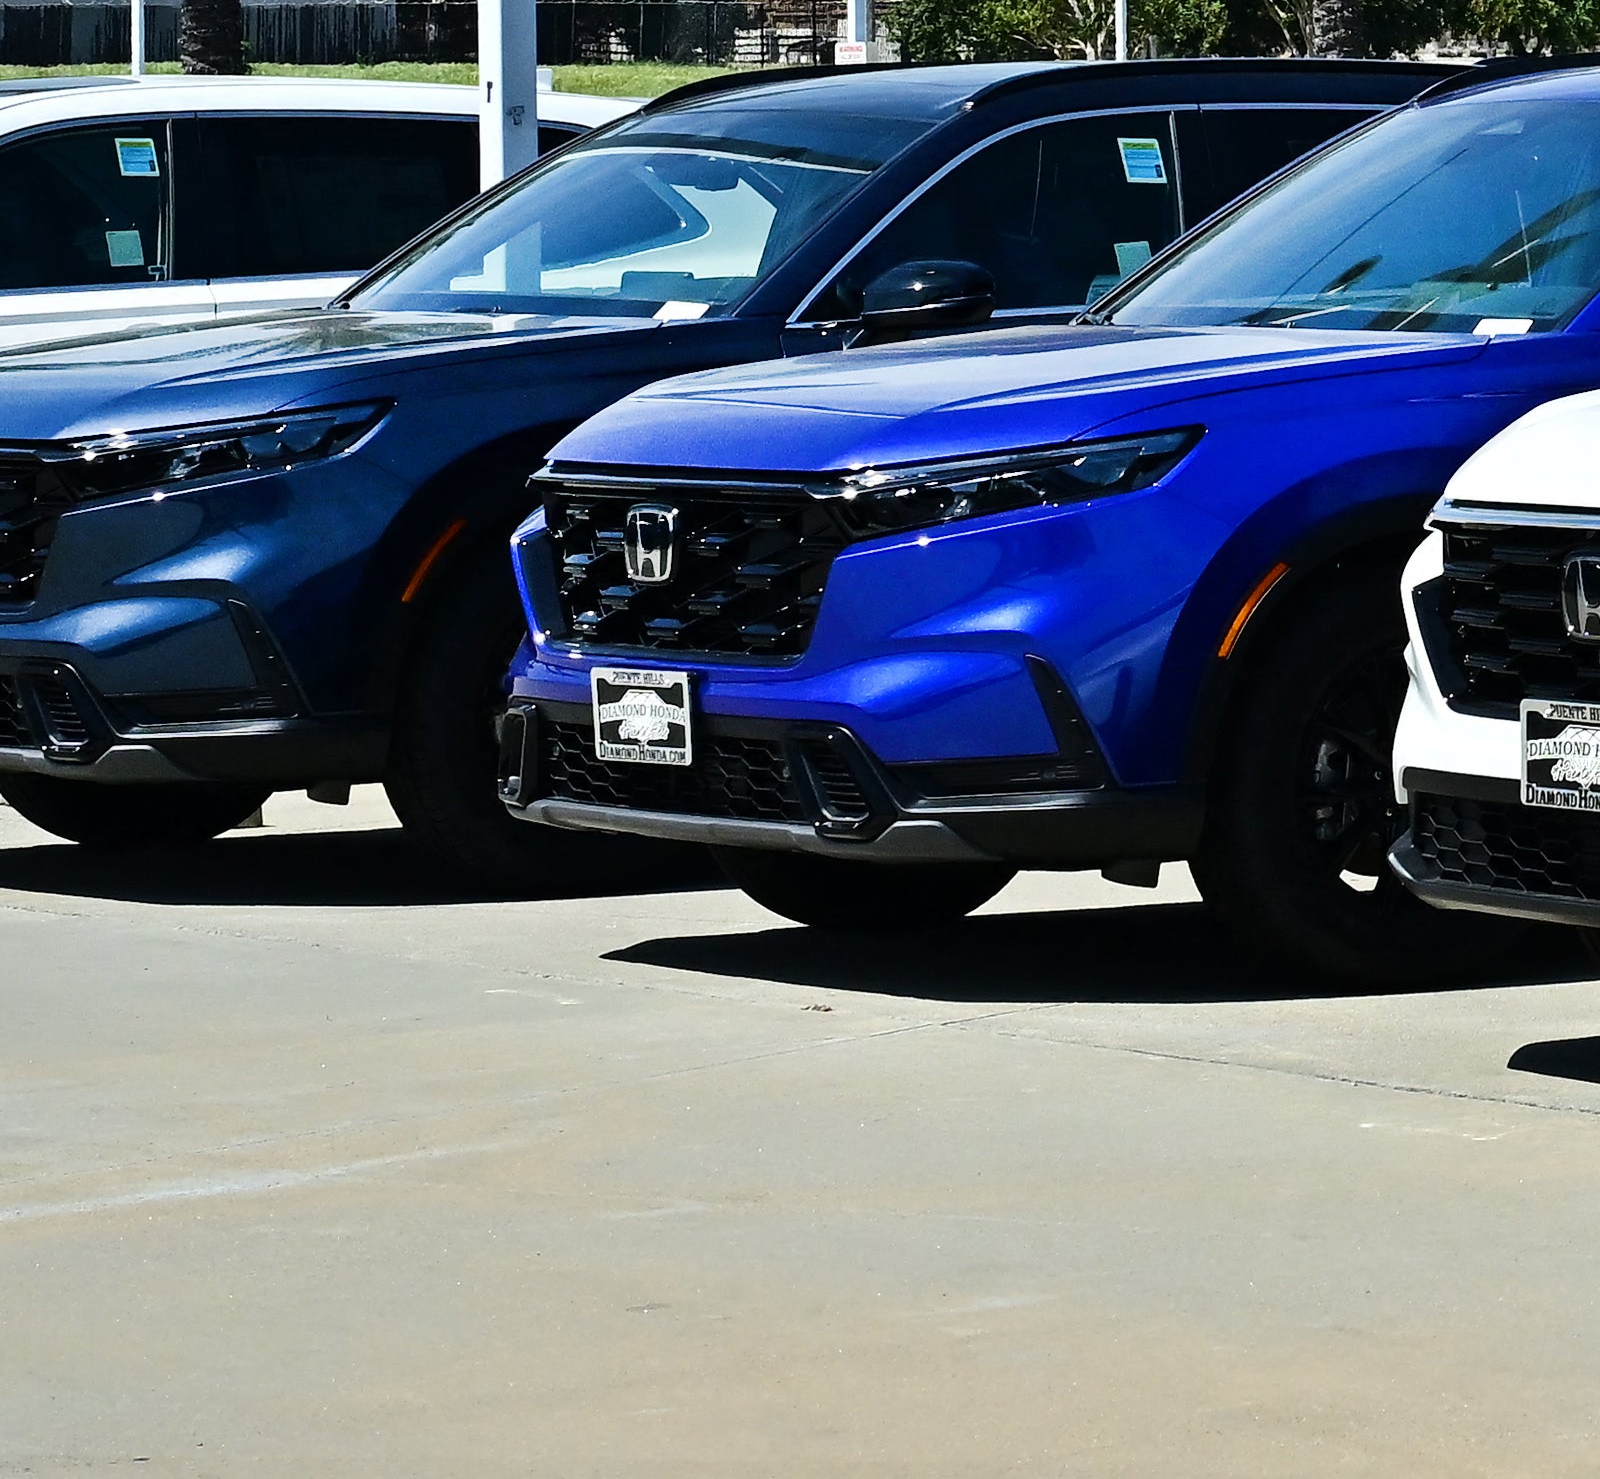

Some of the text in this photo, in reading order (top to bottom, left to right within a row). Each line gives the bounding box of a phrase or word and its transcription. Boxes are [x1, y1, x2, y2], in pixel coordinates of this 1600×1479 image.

[601, 704, 686, 723] DIAMOND HONDA
[1550, 703, 1588, 720] PUENTE
[1529, 740, 1591, 757] DIAMOND
